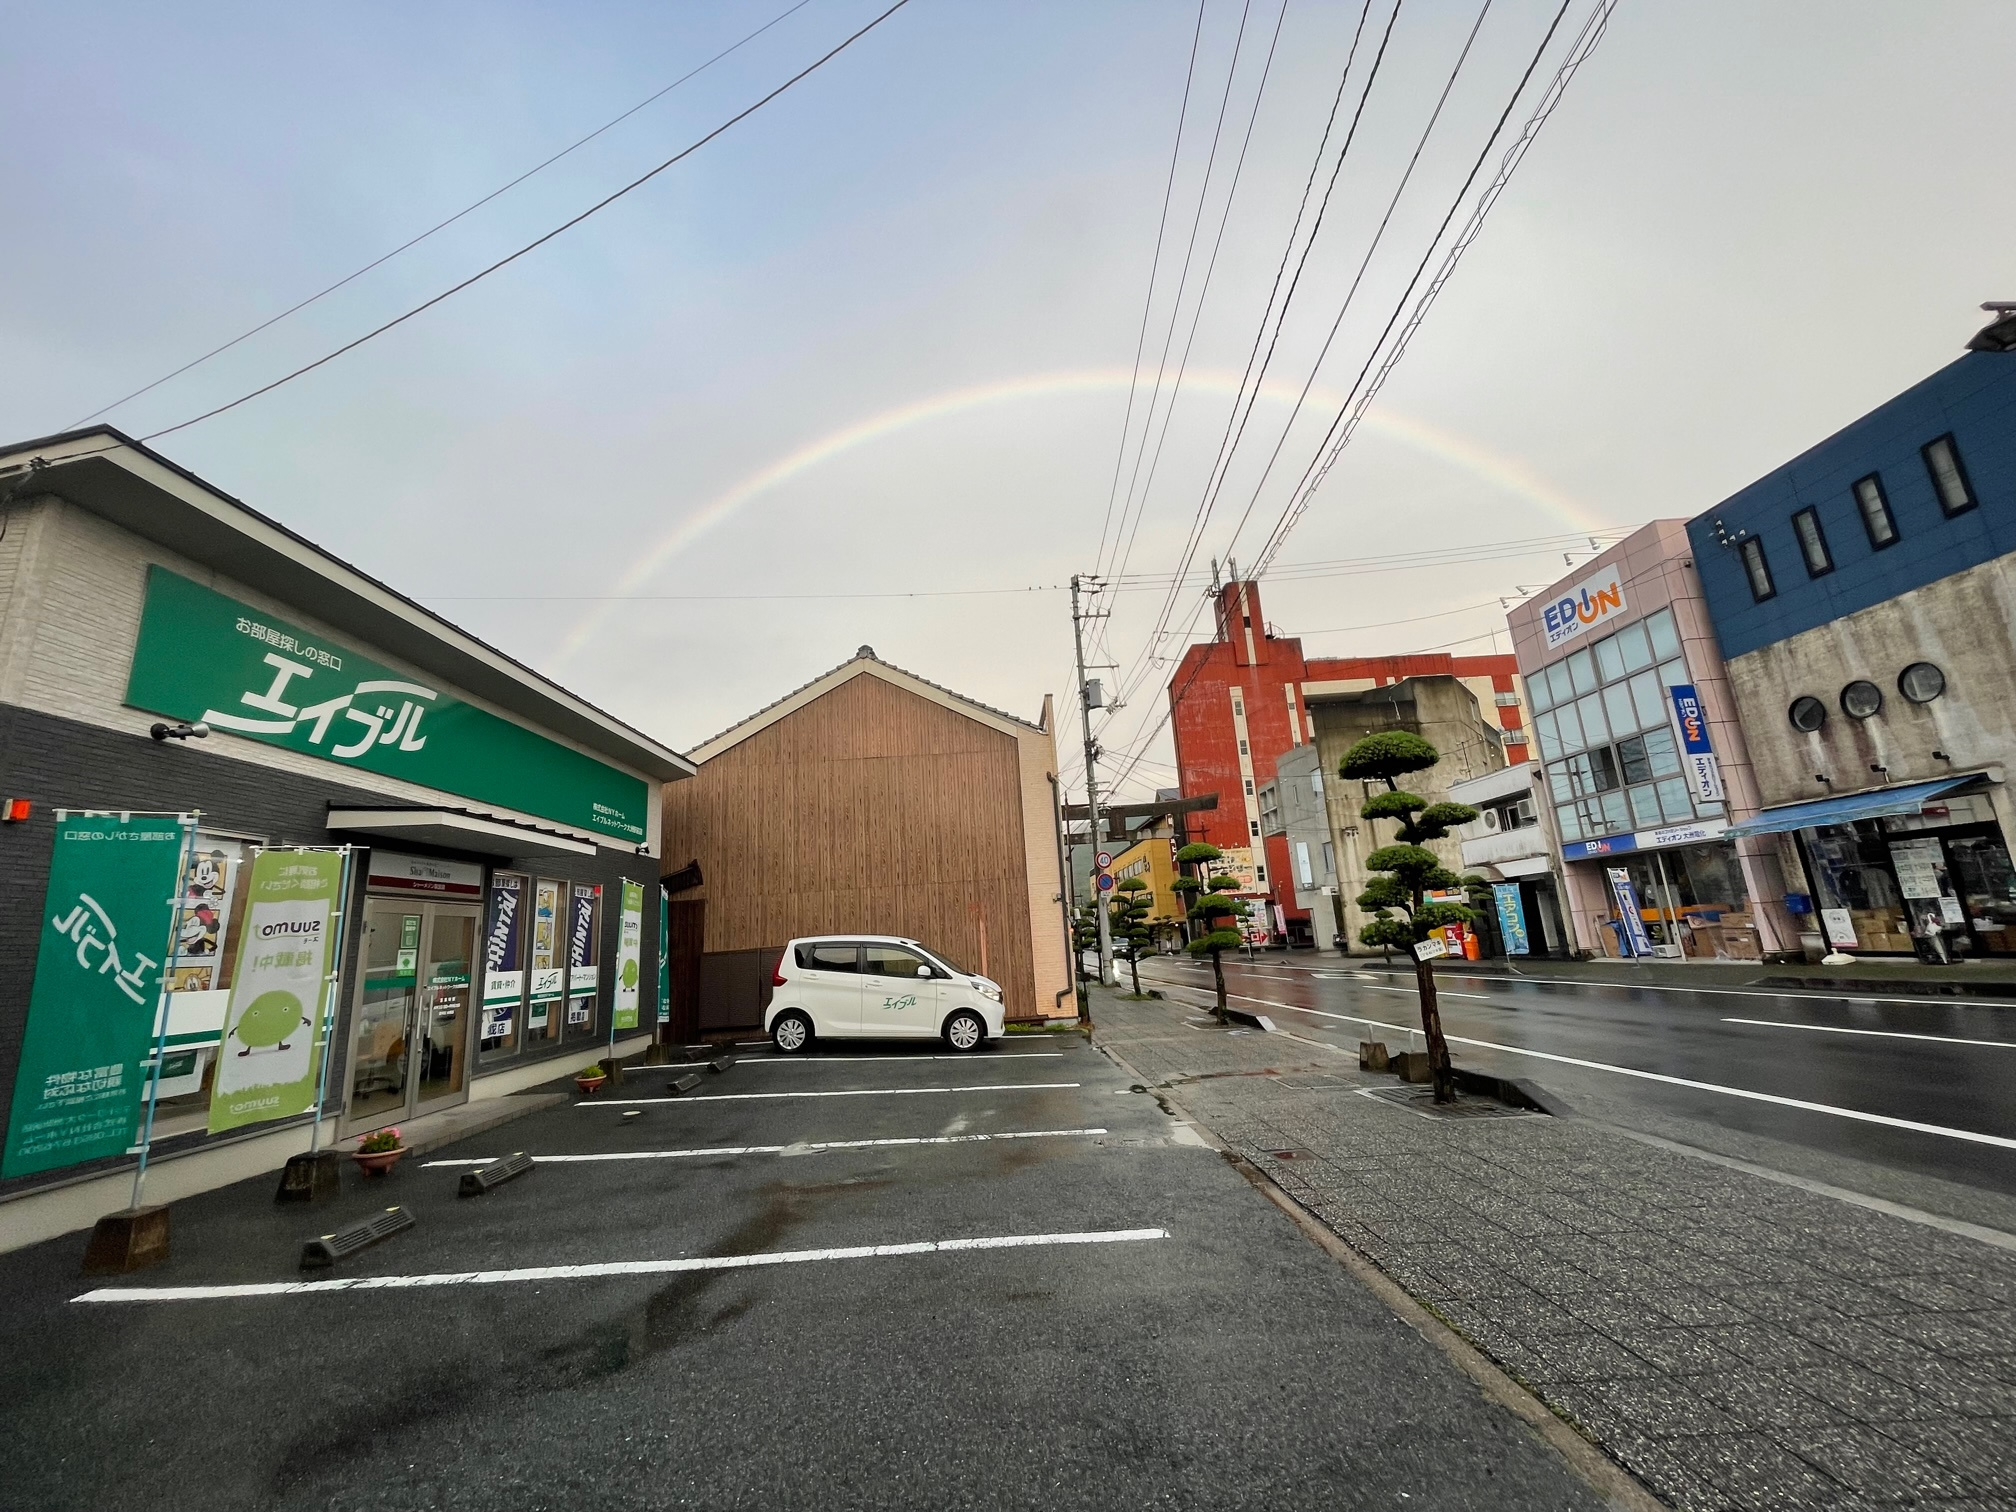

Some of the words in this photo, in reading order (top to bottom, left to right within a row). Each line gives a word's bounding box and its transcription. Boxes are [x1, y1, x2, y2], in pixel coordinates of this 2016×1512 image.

[1544, 581, 1621, 633] EDION
[235, 615, 343, 672] お部屋探しの窓口
[1550, 622, 1578, 643] エディオン
[202, 651, 439, 758] エイブル
[1683, 697, 1701, 742] EDION
[1695, 757, 1712, 797] エディオン
[1100, 856, 1108, 865] 40
[535, 971, 559, 991] エイブル
[882, 993, 917, 1010] エイブル
